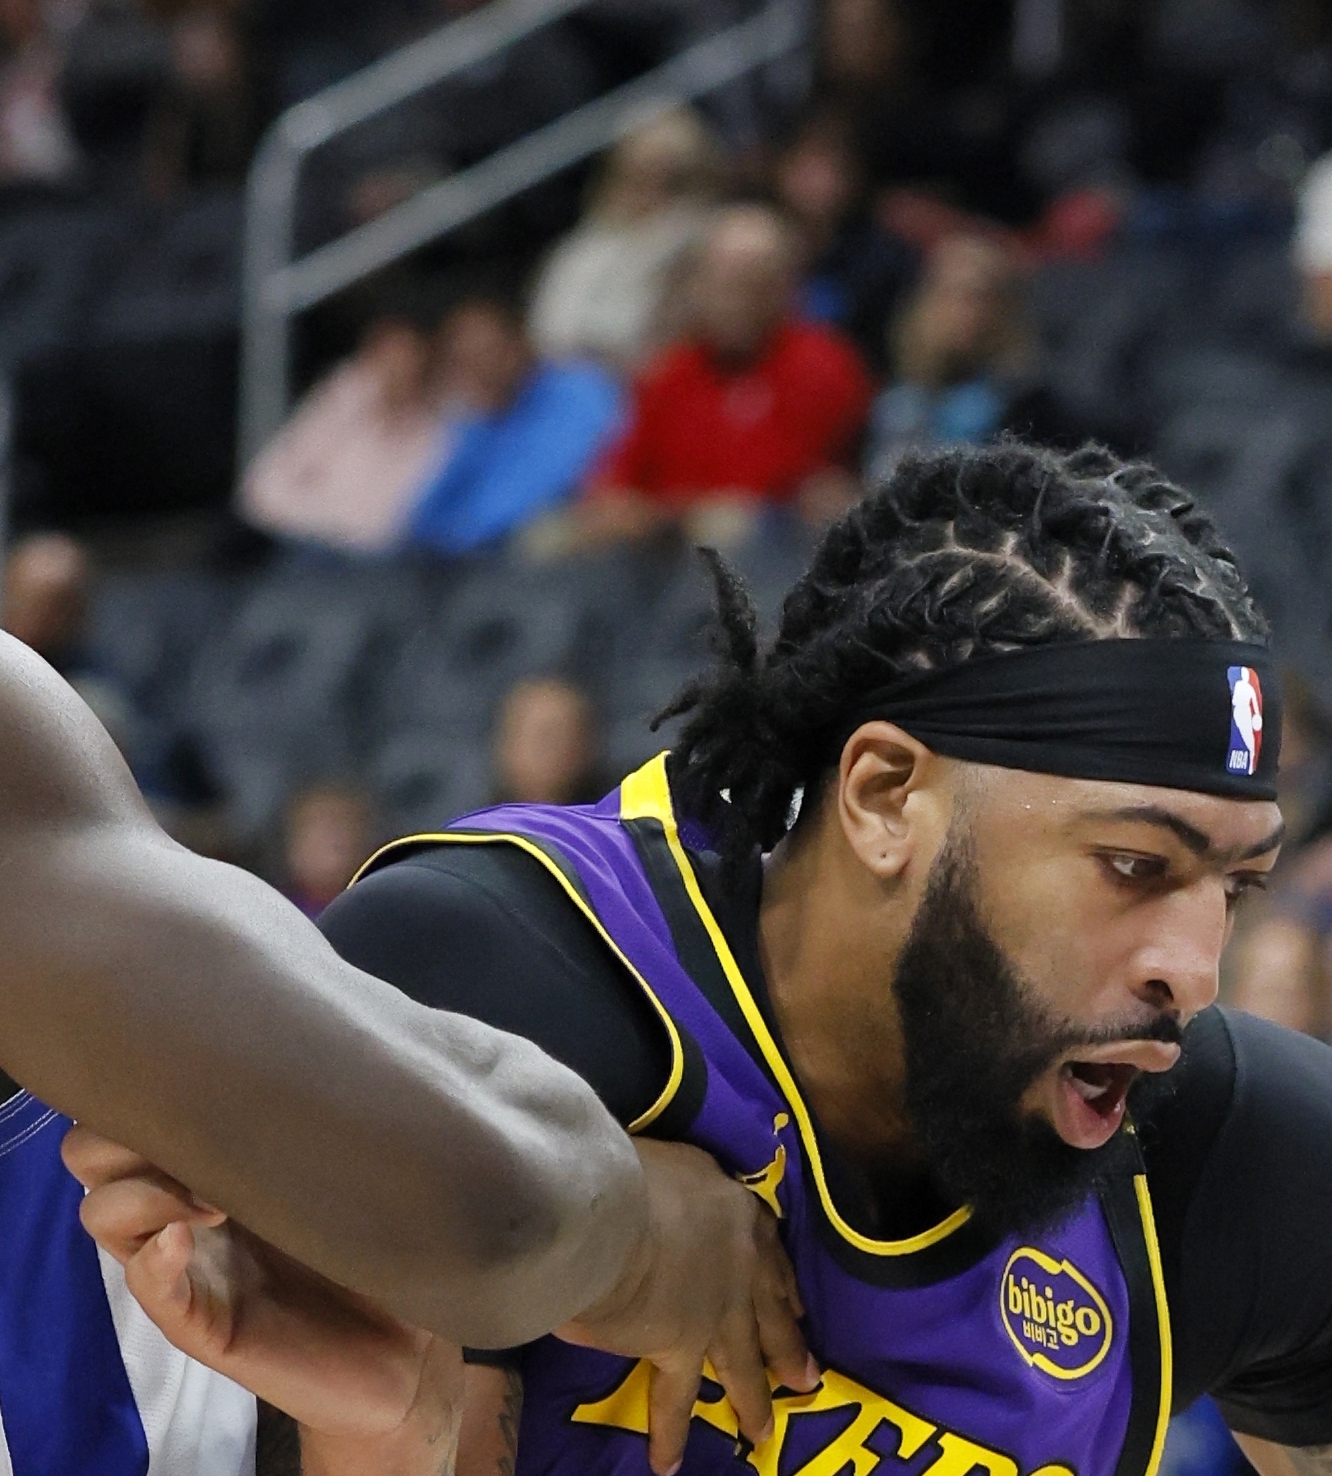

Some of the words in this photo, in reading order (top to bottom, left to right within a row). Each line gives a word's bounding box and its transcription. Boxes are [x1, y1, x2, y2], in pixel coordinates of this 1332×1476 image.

[1230, 750, 1248, 769] NBA
[1008, 1273, 1101, 1346] bibigo
[1022, 1320, 1060, 1351] 비비고
